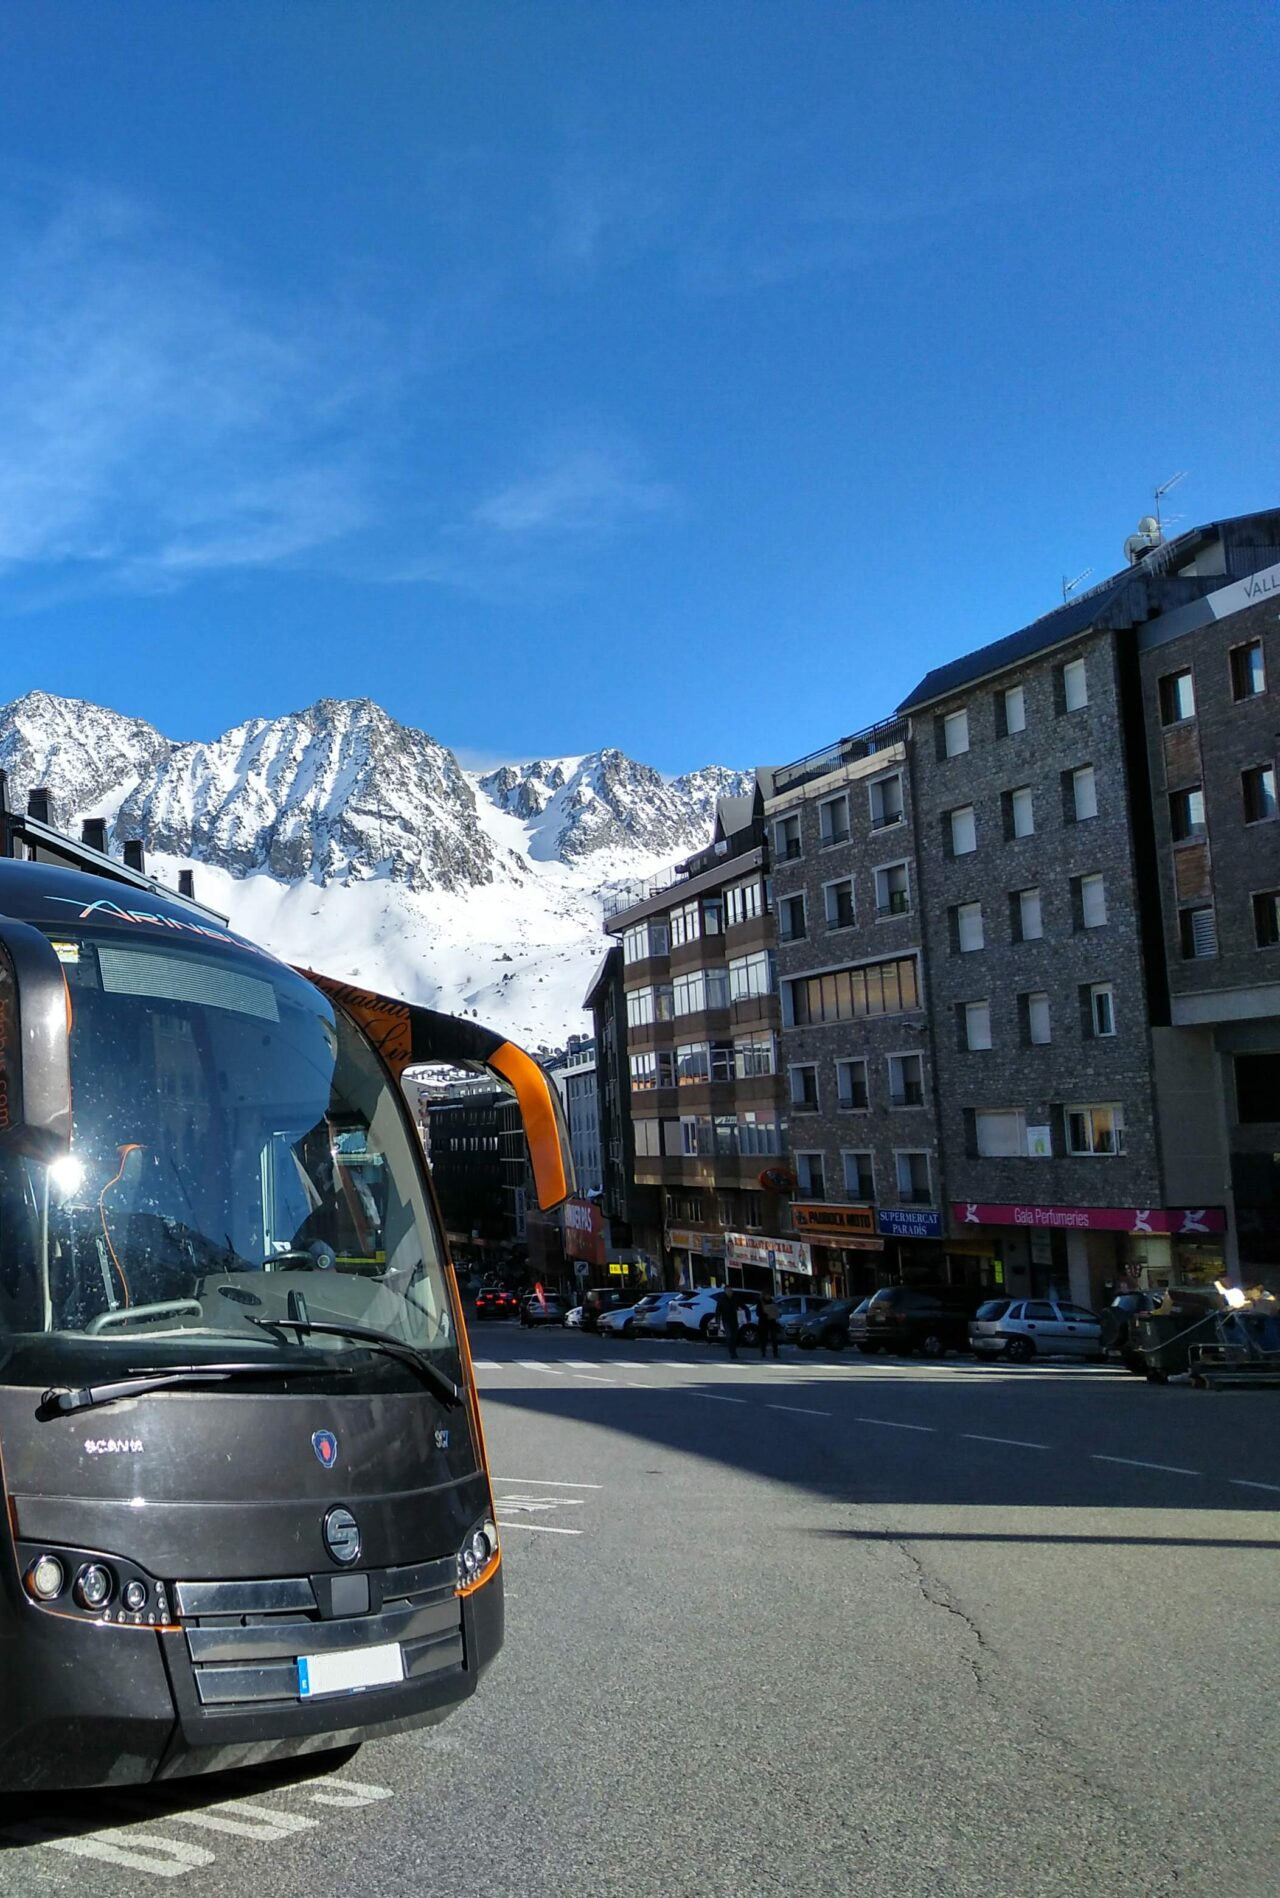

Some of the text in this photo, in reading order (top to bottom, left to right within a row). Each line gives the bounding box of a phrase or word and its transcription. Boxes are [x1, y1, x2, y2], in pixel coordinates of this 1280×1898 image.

[880, 1211, 937, 1224] SUPERMERCAT
[1035, 1209, 1089, 1226] Perfumeries
[84, 1438, 144, 1454] SCANIA
